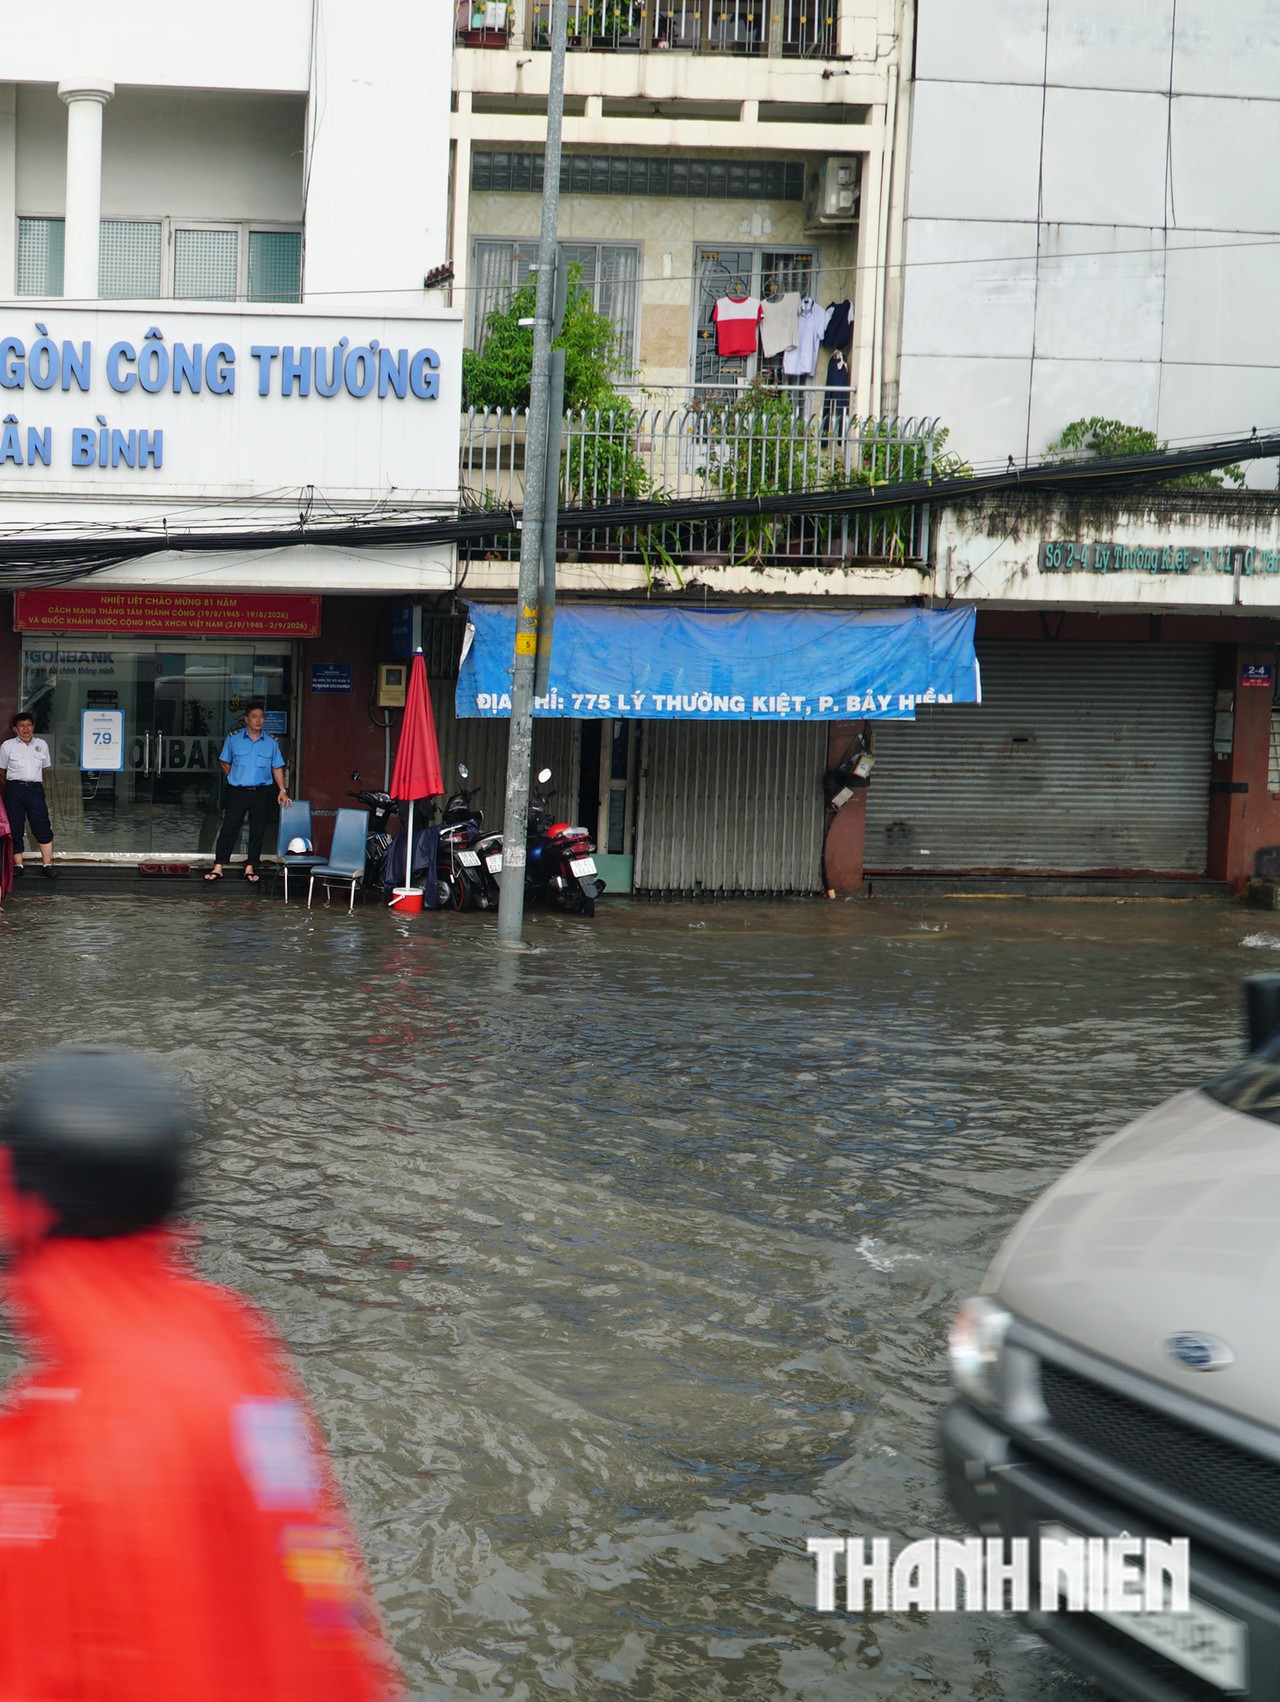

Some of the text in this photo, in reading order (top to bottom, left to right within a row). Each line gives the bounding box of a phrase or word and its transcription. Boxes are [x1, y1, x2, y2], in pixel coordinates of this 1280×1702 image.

[106, 326, 236, 395] CÔNG
[250, 335, 442, 400] THƯƠNG
[71, 414, 164, 469] BÌNH
[1045, 541, 1063, 568] Số
[1066, 543, 1088, 568] 2-4
[100, 595, 238, 607] NHIỆT LIỆT CHÀO MỪNG 81 NĂM
[48, 606, 71, 614] CÁCH
[73, 607, 97, 616] MẠNG
[98, 606, 124, 615] THÁNG
[126, 606, 143, 615] TÁM
[144, 607, 170, 616] THÀNH
[172, 608, 195, 617] CÔNG
[28, 615, 39, 624] VÀ
[41, 615, 65, 625] QUỐC
[66, 615, 93, 625] KHÁNH
[95, 616, 118, 626] NƯỚC
[120, 617, 143, 627] CỘNG
[145, 617, 162, 627] HÒA
[188, 619, 203, 629] VIỆT
[205, 620, 224, 628] NAM
[525, 640, 531, 649] 5
[1248, 666, 1265, 674] 2-4
[476, 693, 512, 714] ĐỊA
[534, 687, 564, 709] HỈ:
[571, 693, 611, 710] 775
[618, 690, 646, 711] LÝ
[652, 689, 746, 713] THƯỜNG
[752, 692, 812, 716] KIỆT,
[818, 696, 839, 712] P.
[846, 689, 891, 712] BẢY
[92, 732, 112, 745] 7.9
